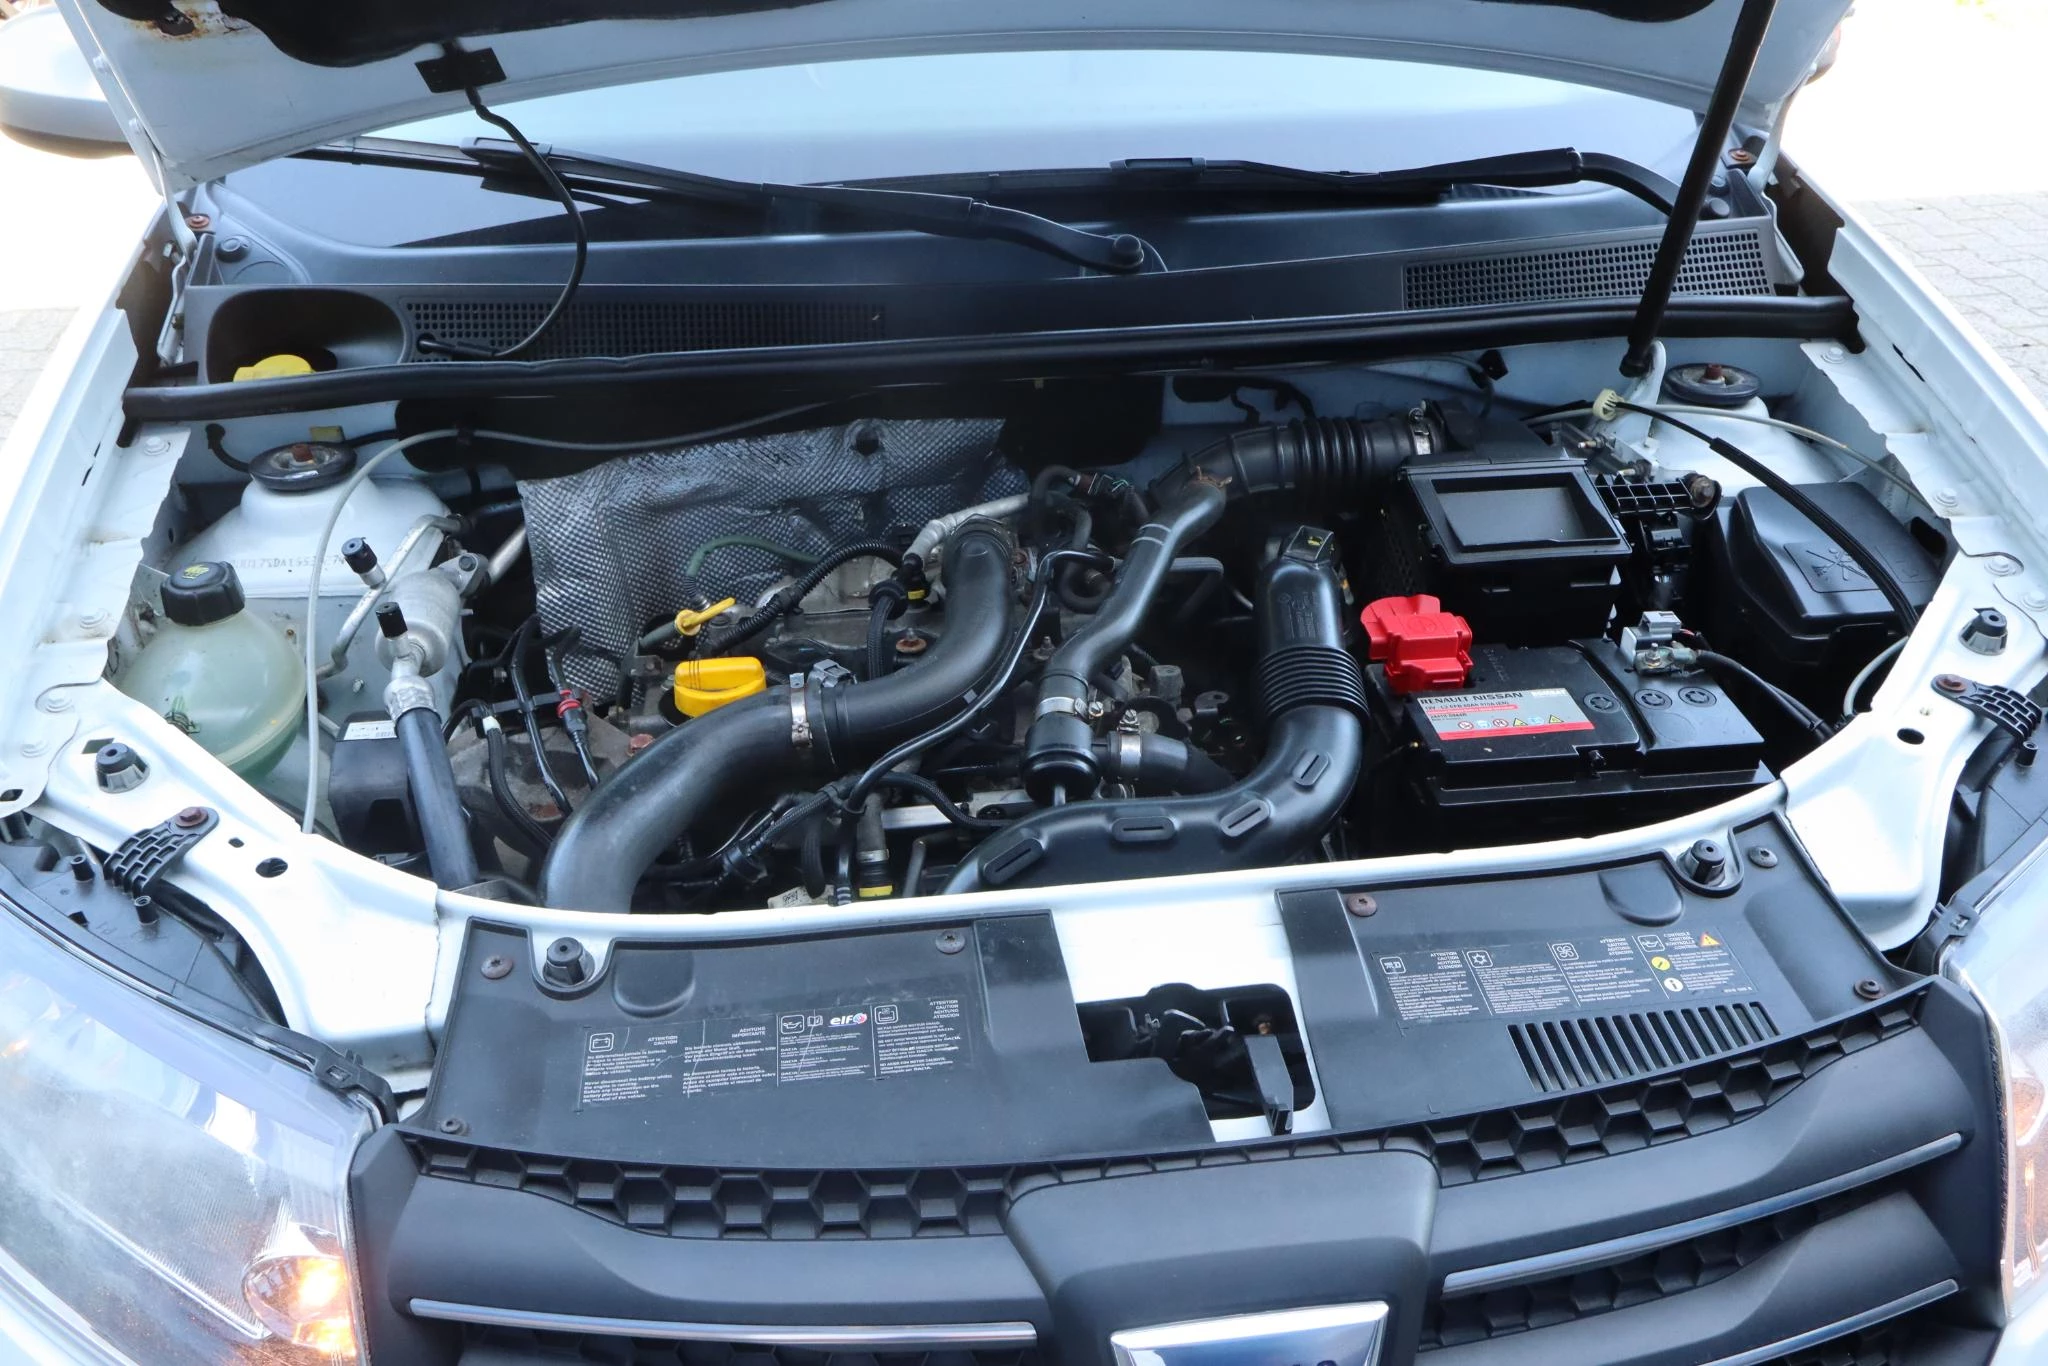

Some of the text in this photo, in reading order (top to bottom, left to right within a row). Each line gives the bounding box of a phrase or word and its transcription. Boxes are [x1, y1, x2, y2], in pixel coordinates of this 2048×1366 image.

[1420, 692, 1523, 705] RENAULT NISSAN
[830, 1015, 854, 1025] elf
